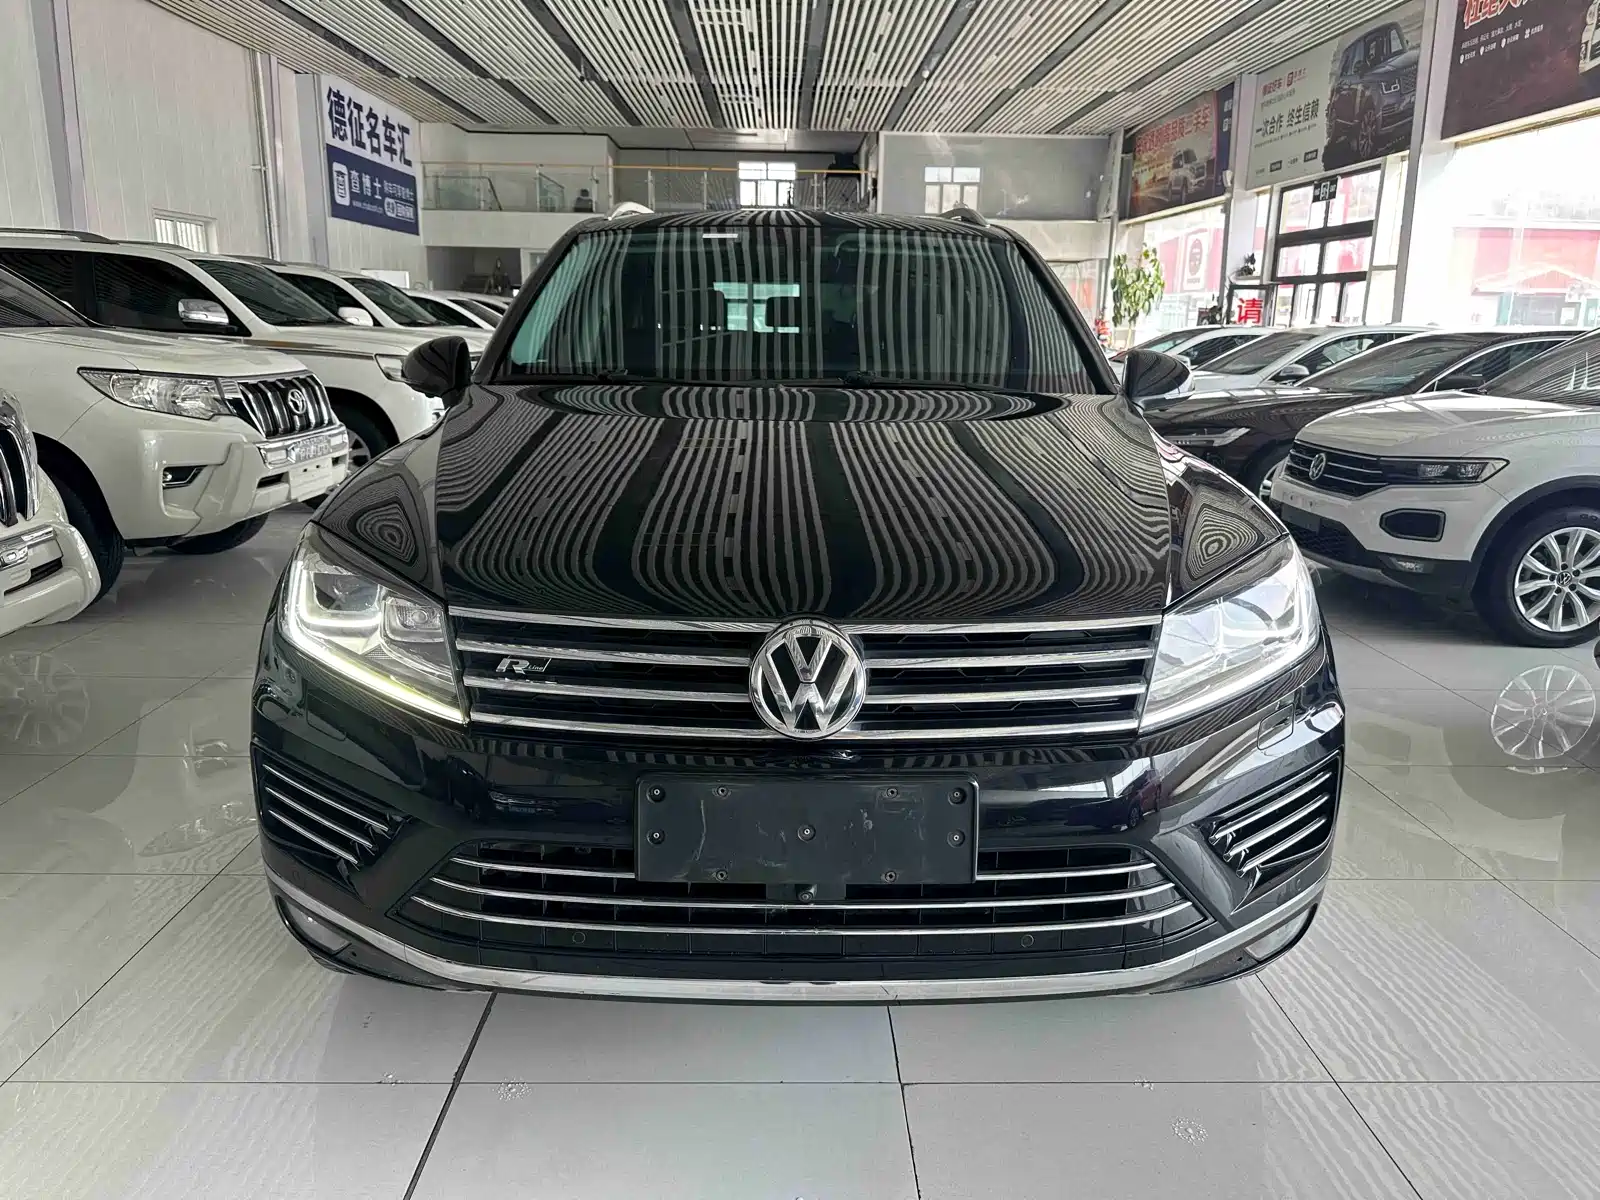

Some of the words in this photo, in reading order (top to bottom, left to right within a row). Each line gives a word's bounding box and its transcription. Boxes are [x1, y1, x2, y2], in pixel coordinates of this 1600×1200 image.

[327, 86, 412, 167] 德征名车汇
[1237, 297, 1263, 324] 请
